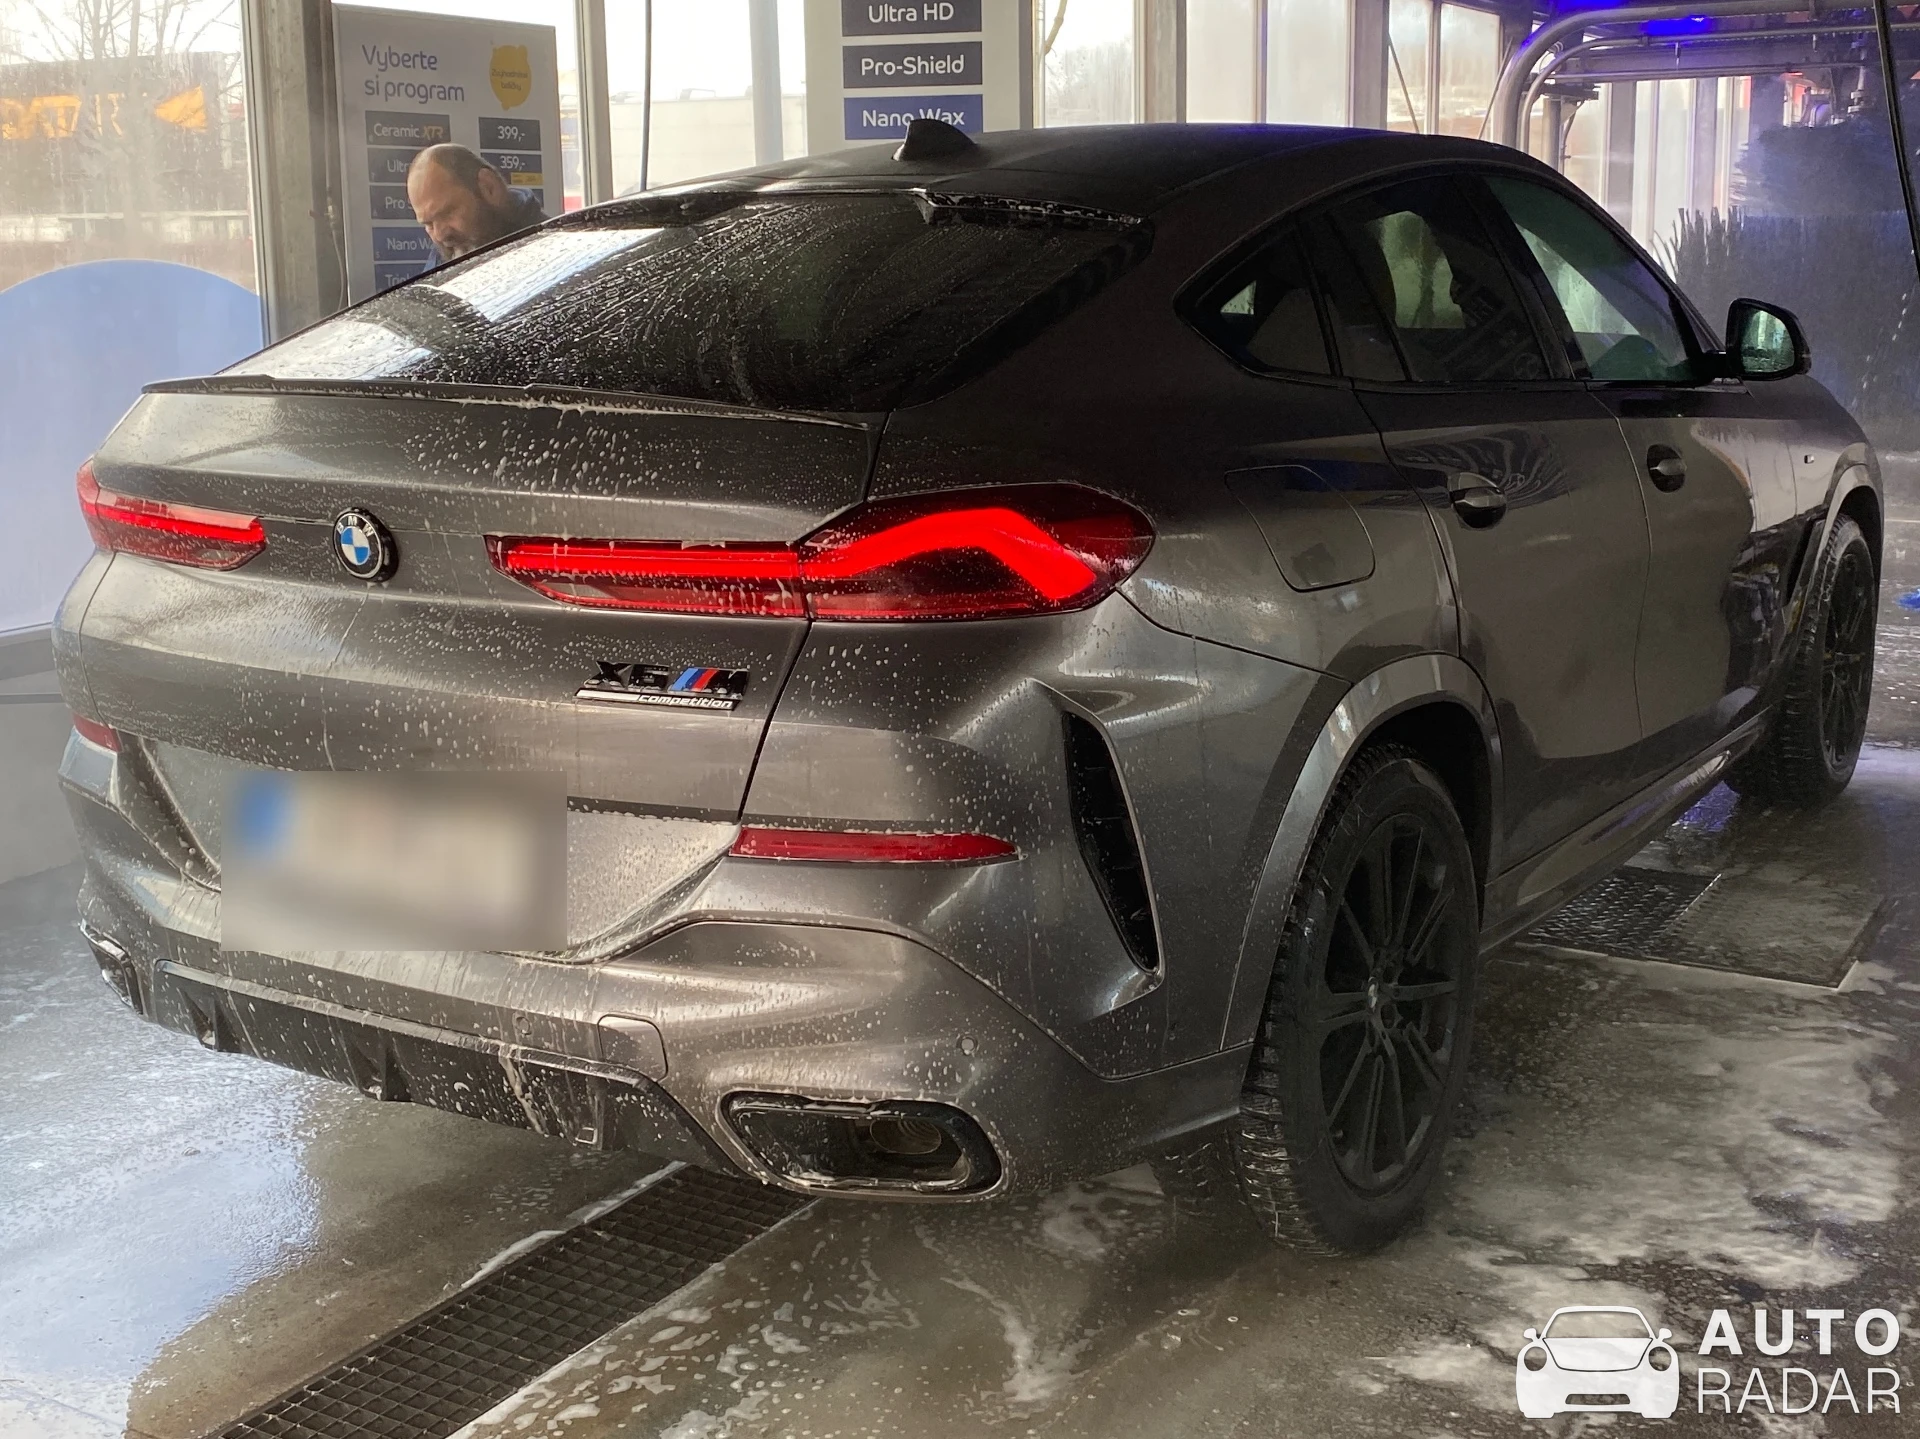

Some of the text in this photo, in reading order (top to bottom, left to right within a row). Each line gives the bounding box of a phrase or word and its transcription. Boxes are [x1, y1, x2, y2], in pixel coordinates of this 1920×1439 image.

[868, 2, 955, 23] Ultra HD
[361, 44, 438, 72] Vyberte
[861, 54, 965, 76] Pro-Shield
[364, 73, 465, 105] si program
[862, 109, 915, 127] Nano
[373, 122, 420, 138] Ceramic
[386, 237, 418, 251] Nano
[336, 515, 375, 537] BMW
